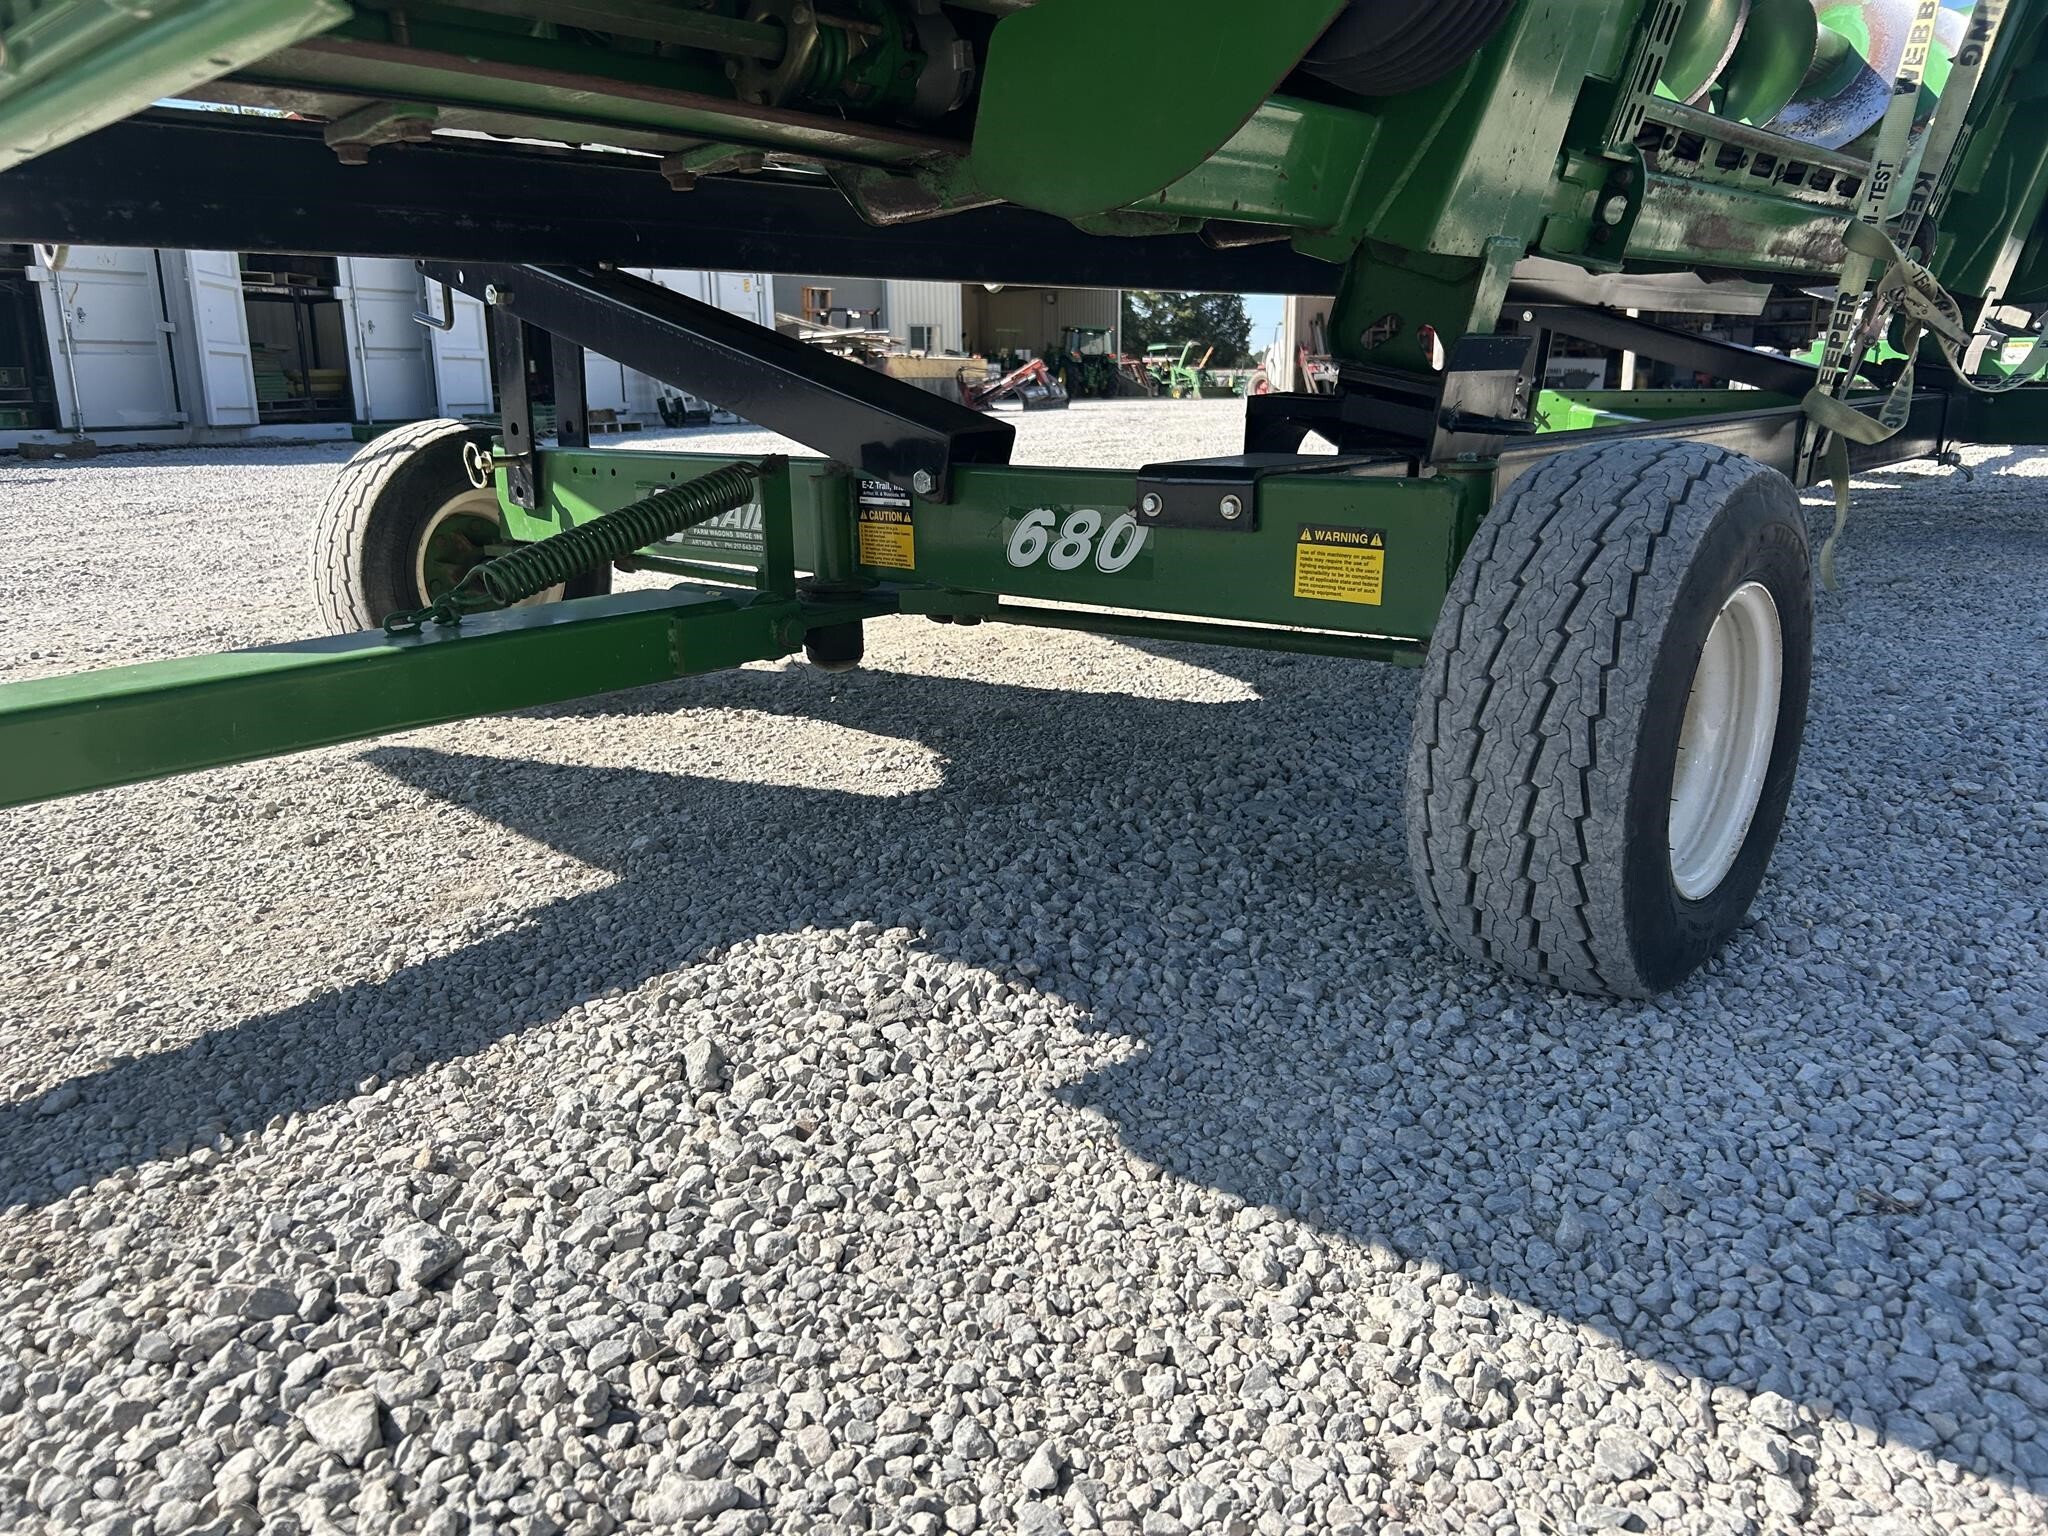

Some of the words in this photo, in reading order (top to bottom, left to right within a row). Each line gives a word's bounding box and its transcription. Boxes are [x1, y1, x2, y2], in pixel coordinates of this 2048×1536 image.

[1822, 292, 1859, 385] EEPER
[862, 481, 874, 489] E-Z
[875, 481, 891, 491] Trail,
[869, 510, 902, 522] CAUTION
[694, 528, 709, 536] FARM
[710, 529, 733, 538] WAGONS
[736, 532, 752, 540] SINCE
[1314, 530, 1368, 544] WARNING
[1007, 508, 1149, 574] 680
